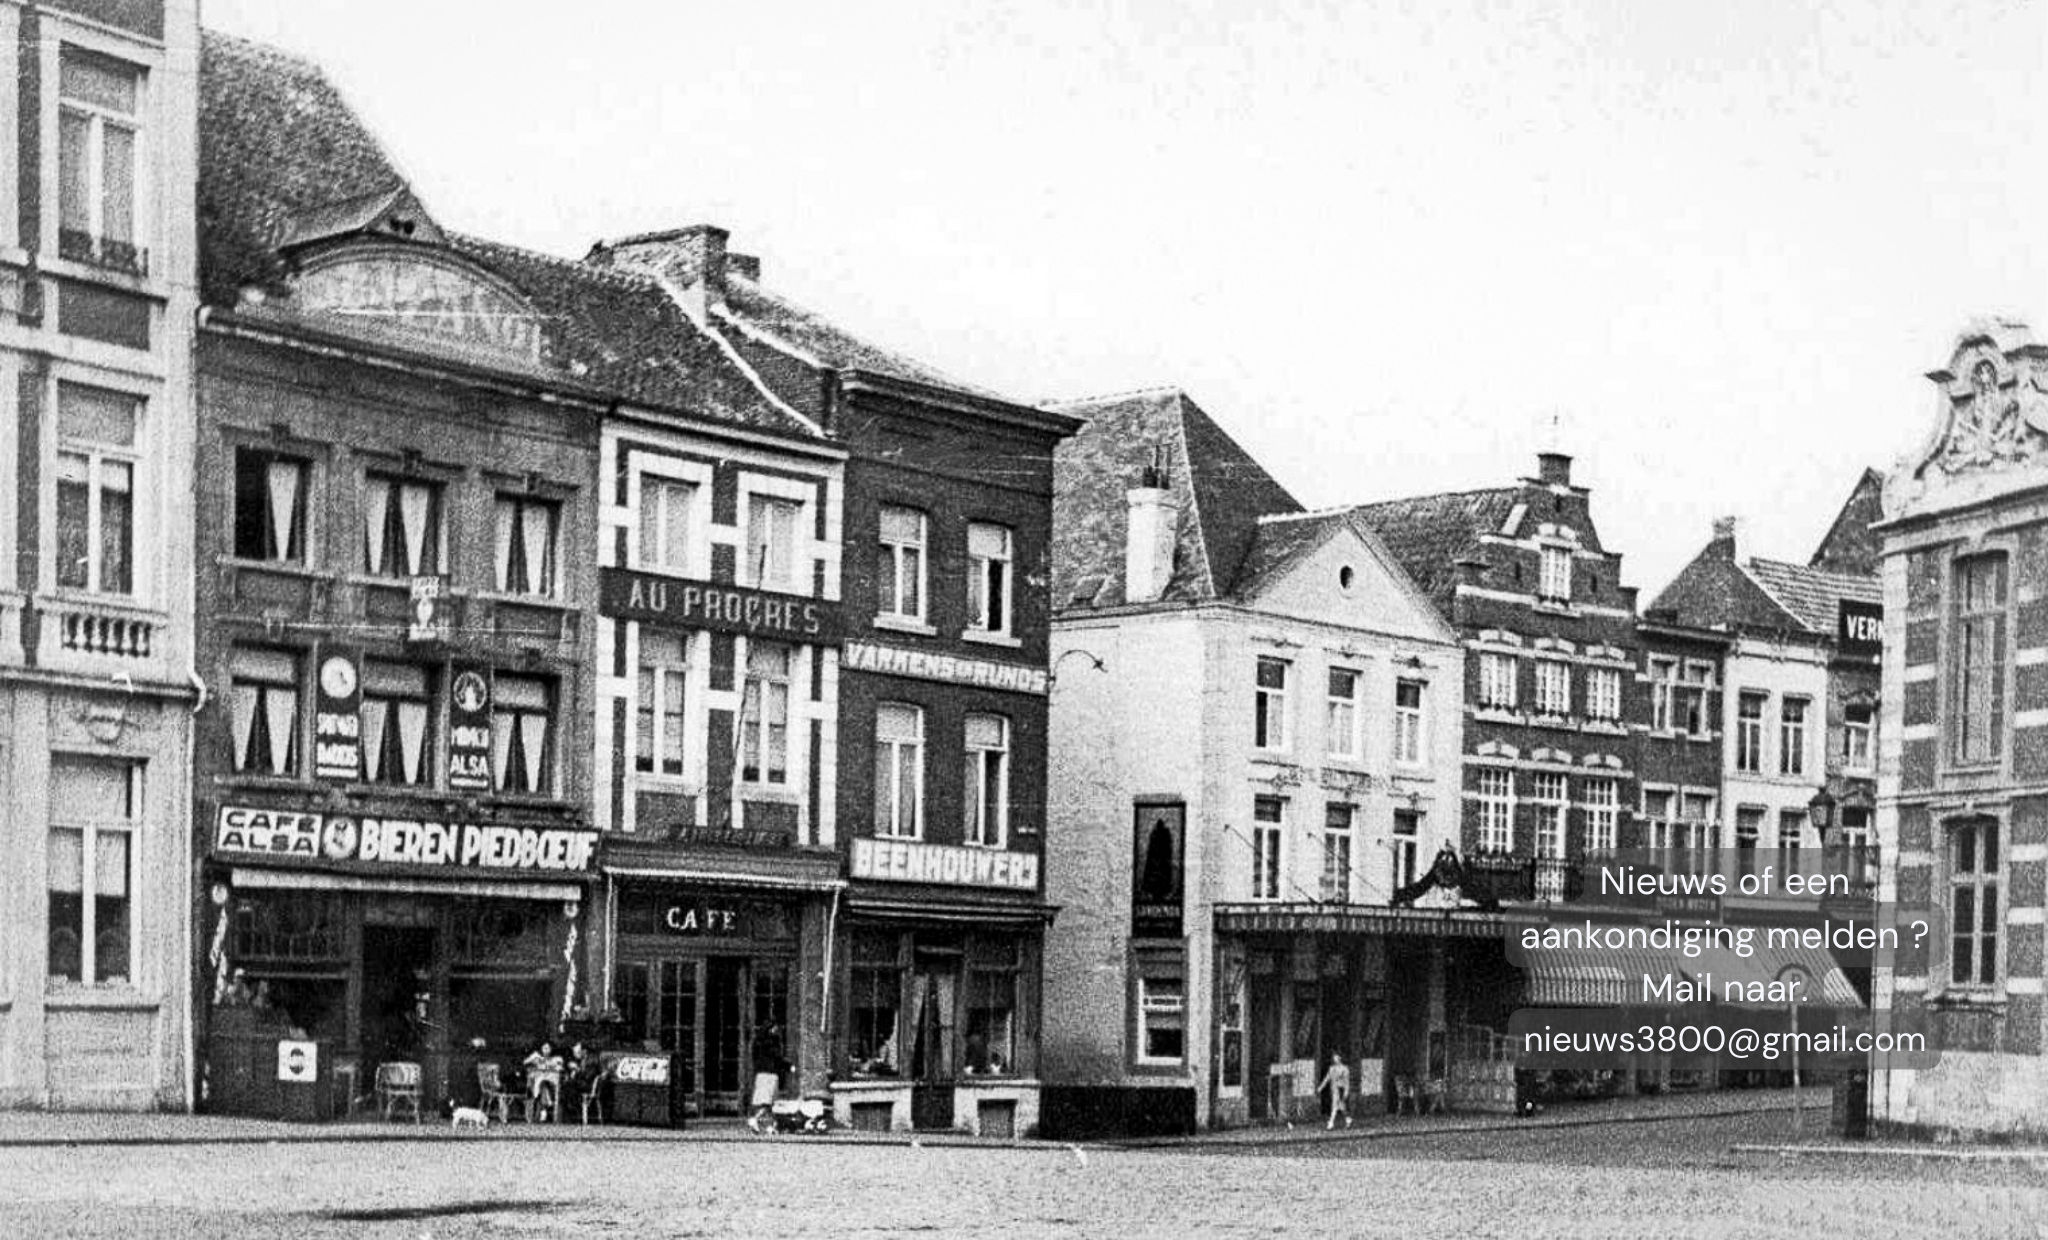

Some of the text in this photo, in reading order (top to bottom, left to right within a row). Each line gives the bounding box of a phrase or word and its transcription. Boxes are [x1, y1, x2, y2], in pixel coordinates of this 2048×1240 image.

[629, 579, 668, 612] AU
[450, 754, 490, 777] ALSA
[222, 831, 314, 853] ALSA
[359, 818, 459, 865] BIEREN
